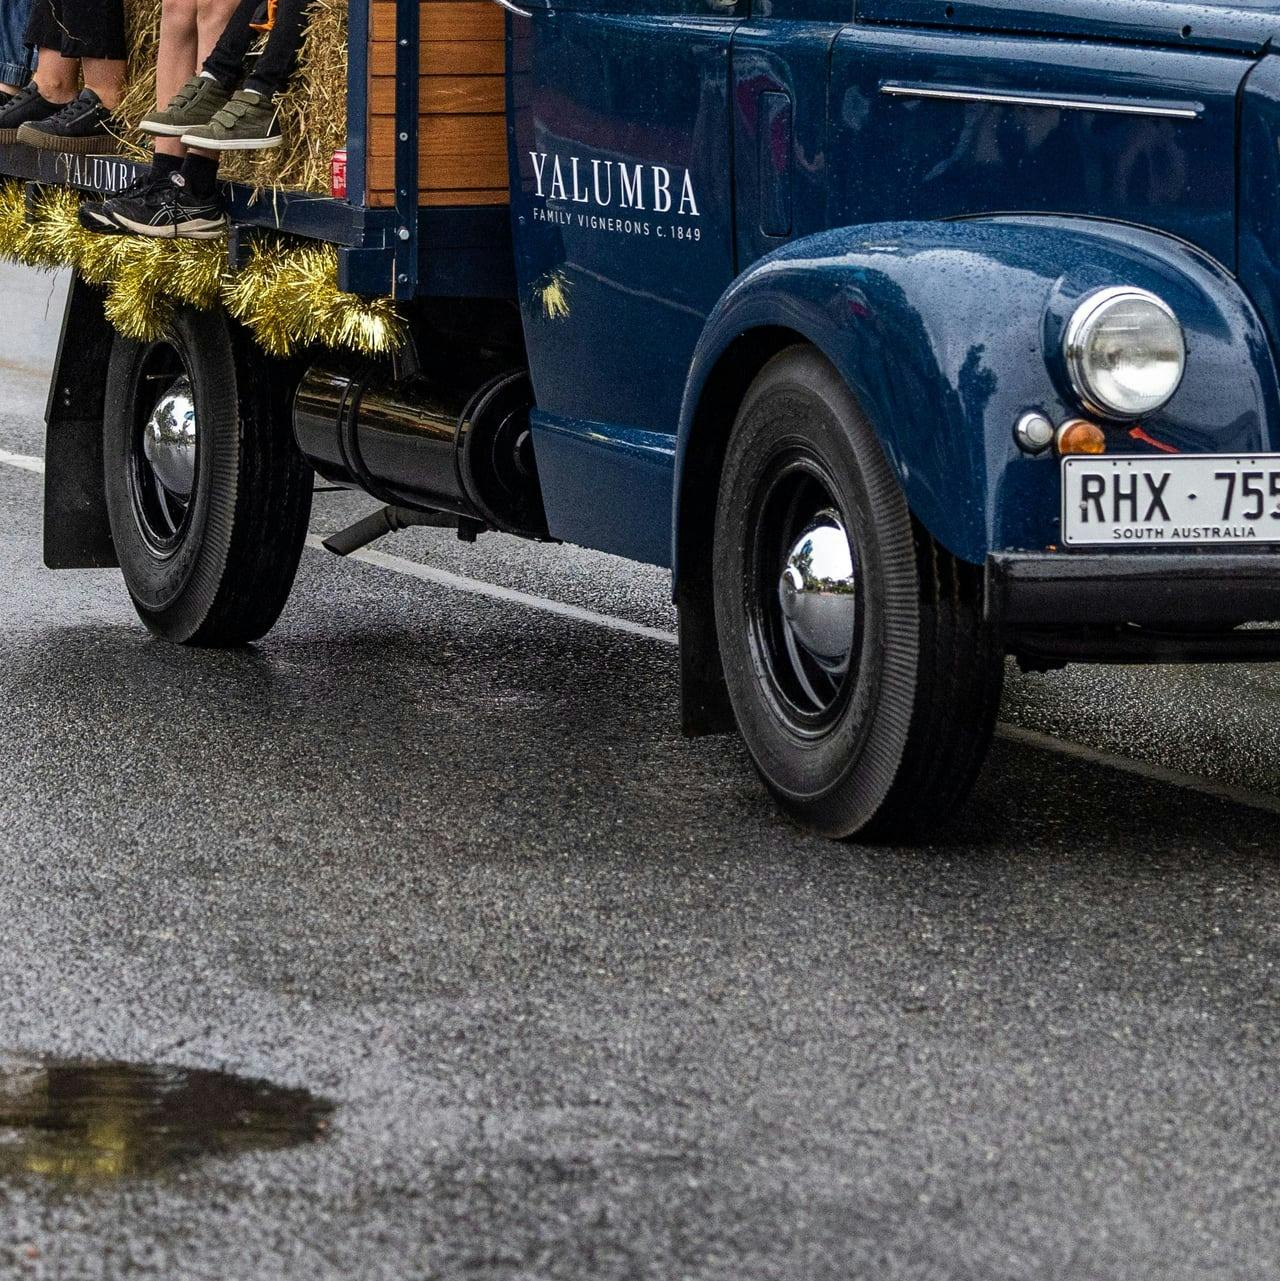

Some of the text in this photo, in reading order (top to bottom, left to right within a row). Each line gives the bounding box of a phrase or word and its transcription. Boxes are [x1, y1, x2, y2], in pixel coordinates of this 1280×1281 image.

[529, 150, 701, 216] YALUMBA
[532, 207, 572, 226] FAMILY
[577, 214, 650, 236] VIGNERONS
[670, 225, 701, 242] 1849
[1112, 526, 1257, 539] SOUTH AUSTRALIA
